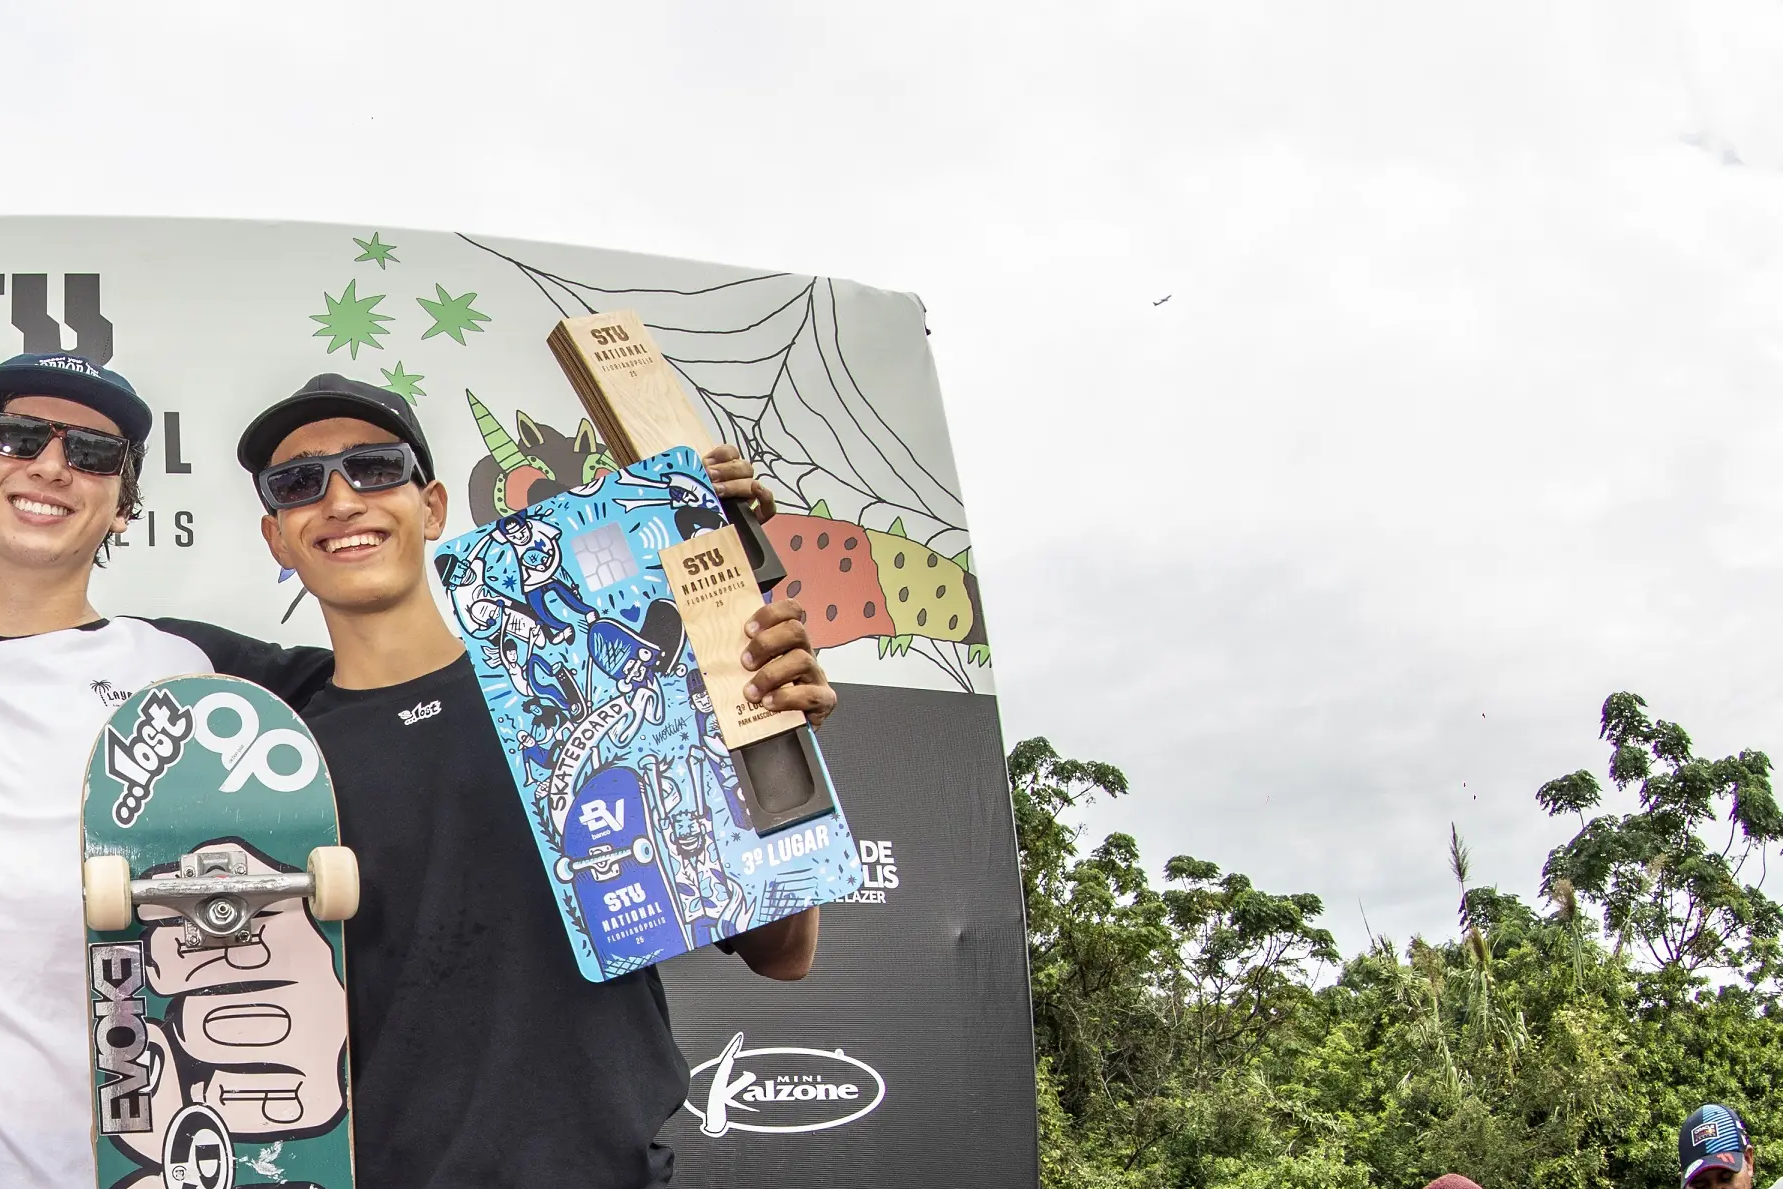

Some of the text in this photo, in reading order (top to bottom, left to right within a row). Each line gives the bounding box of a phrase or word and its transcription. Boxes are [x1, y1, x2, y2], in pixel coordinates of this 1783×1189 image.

[591, 324, 630, 346] STU
[594, 344, 648, 362] NATIONAL
[683, 548, 724, 575] STU
[681, 567, 741, 596] NATIONAL
[550, 702, 623, 812] SKATEBOARD
[591, 830, 611, 840] banco
[766, 825, 830, 867] LUGAR
[603, 882, 646, 912] STU
[601, 902, 662, 932] NATIONAL
[607, 917, 666, 943] FLORIANÓPOLIS
[635, 936, 645, 945] 25
[89, 941, 154, 1136] EVOKE
[702, 1034, 859, 1136] Kalzone
